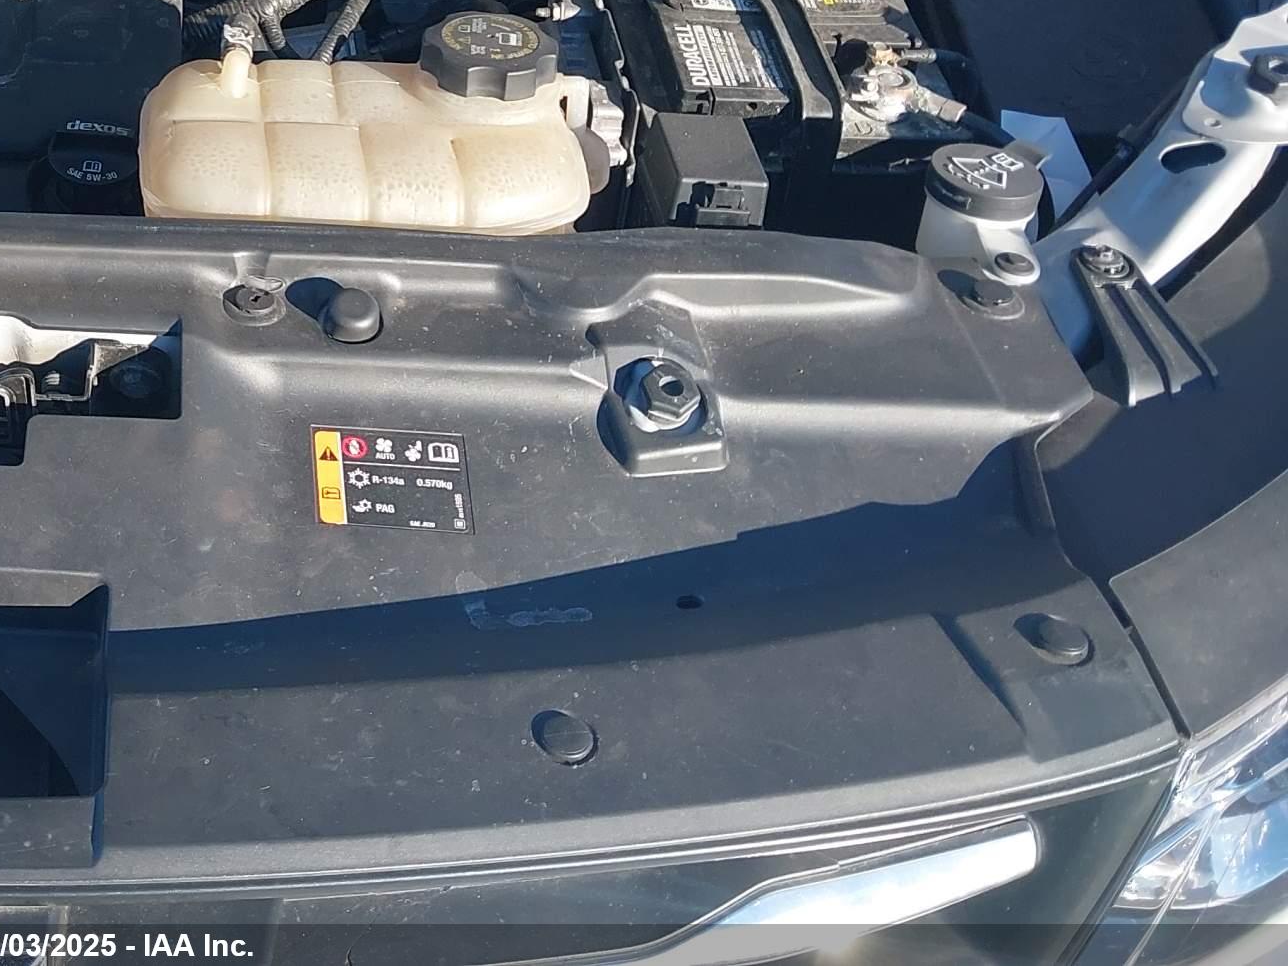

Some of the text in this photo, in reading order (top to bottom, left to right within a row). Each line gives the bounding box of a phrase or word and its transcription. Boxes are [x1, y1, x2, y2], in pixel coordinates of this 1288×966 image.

[674, 23, 710, 85] DURACELL
[66, 119, 131, 136] dexos
[67, 167, 83, 179] SAE
[375, 452, 396, 460] AUTO
[372, 475, 405, 486] R-134a
[375, 503, 395, 514] PAG
